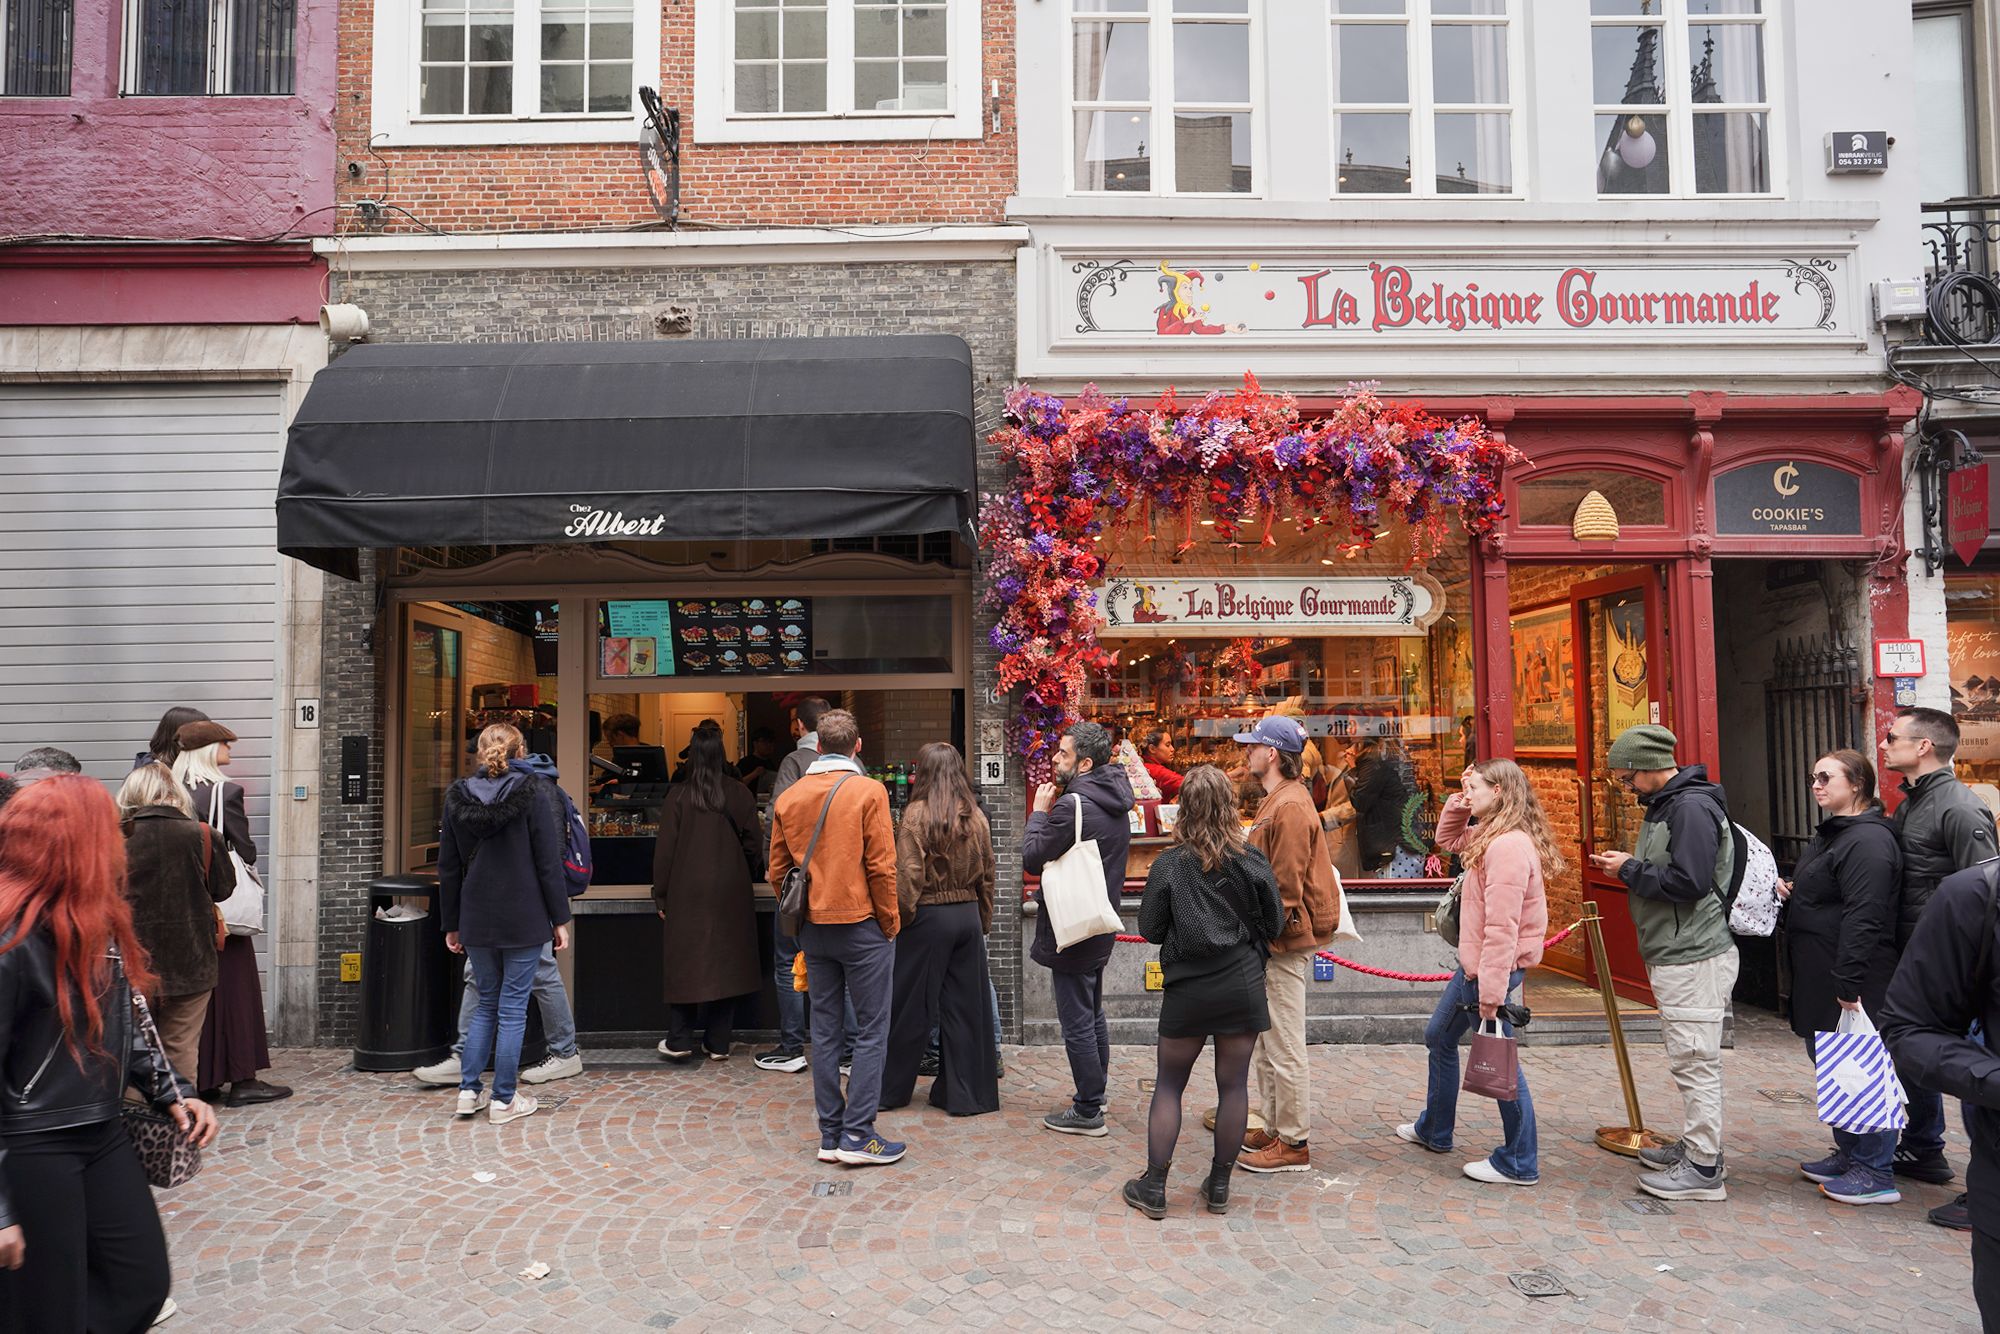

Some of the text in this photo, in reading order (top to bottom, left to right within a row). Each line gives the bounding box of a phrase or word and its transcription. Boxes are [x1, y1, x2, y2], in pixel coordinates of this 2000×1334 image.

[1298, 261, 1780, 332] La Belgique Gourmande
[570, 504, 592, 512] Chez
[1752, 508, 1824, 521] COOKIE'S
[564, 510, 666, 537] Albert
[1183, 582, 1397, 621] La Belgique Gourmande
[1888, 643, 1912, 652] H100
[982, 687, 1000, 704] 16
[301, 705, 314, 721] 18
[1651, 707, 1659, 718] 14
[986, 762, 1000, 778] 16
